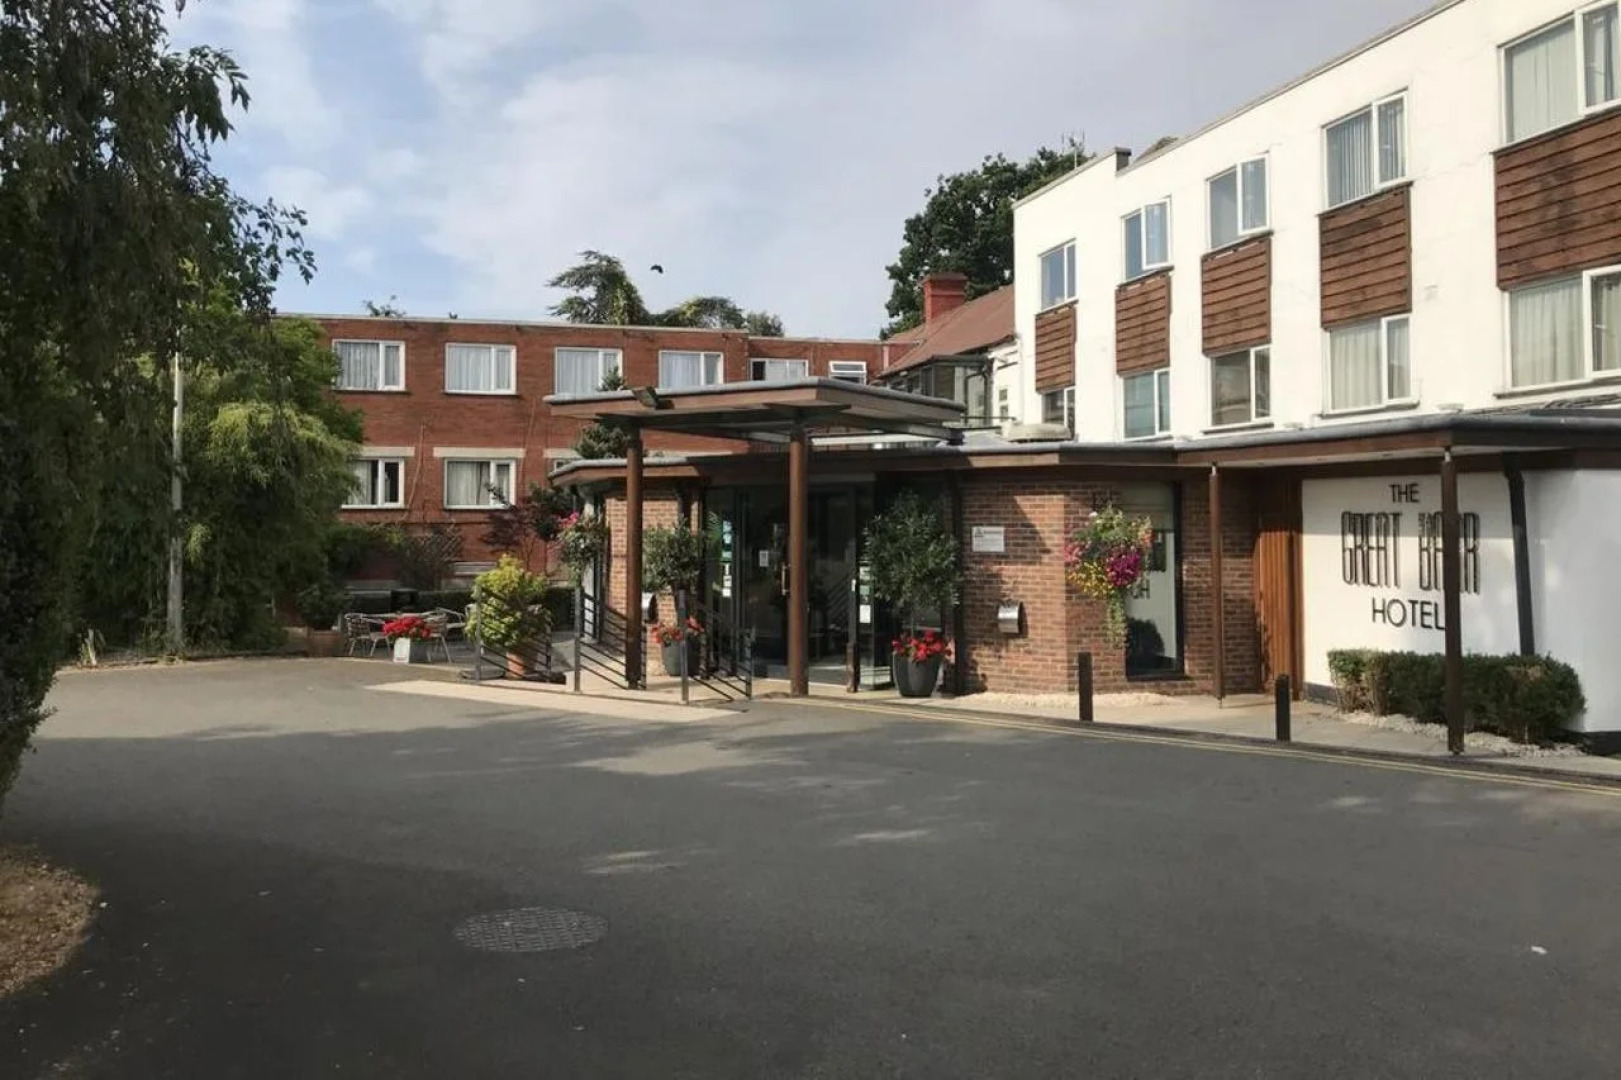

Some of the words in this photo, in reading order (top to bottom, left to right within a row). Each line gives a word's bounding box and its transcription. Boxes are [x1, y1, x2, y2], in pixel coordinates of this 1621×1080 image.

[1388, 483, 1419, 503] THE
[1341, 511, 1402, 588] GREAT
[1418, 511, 1480, 595] BAR
[1371, 597, 1446, 630] HOTEL
